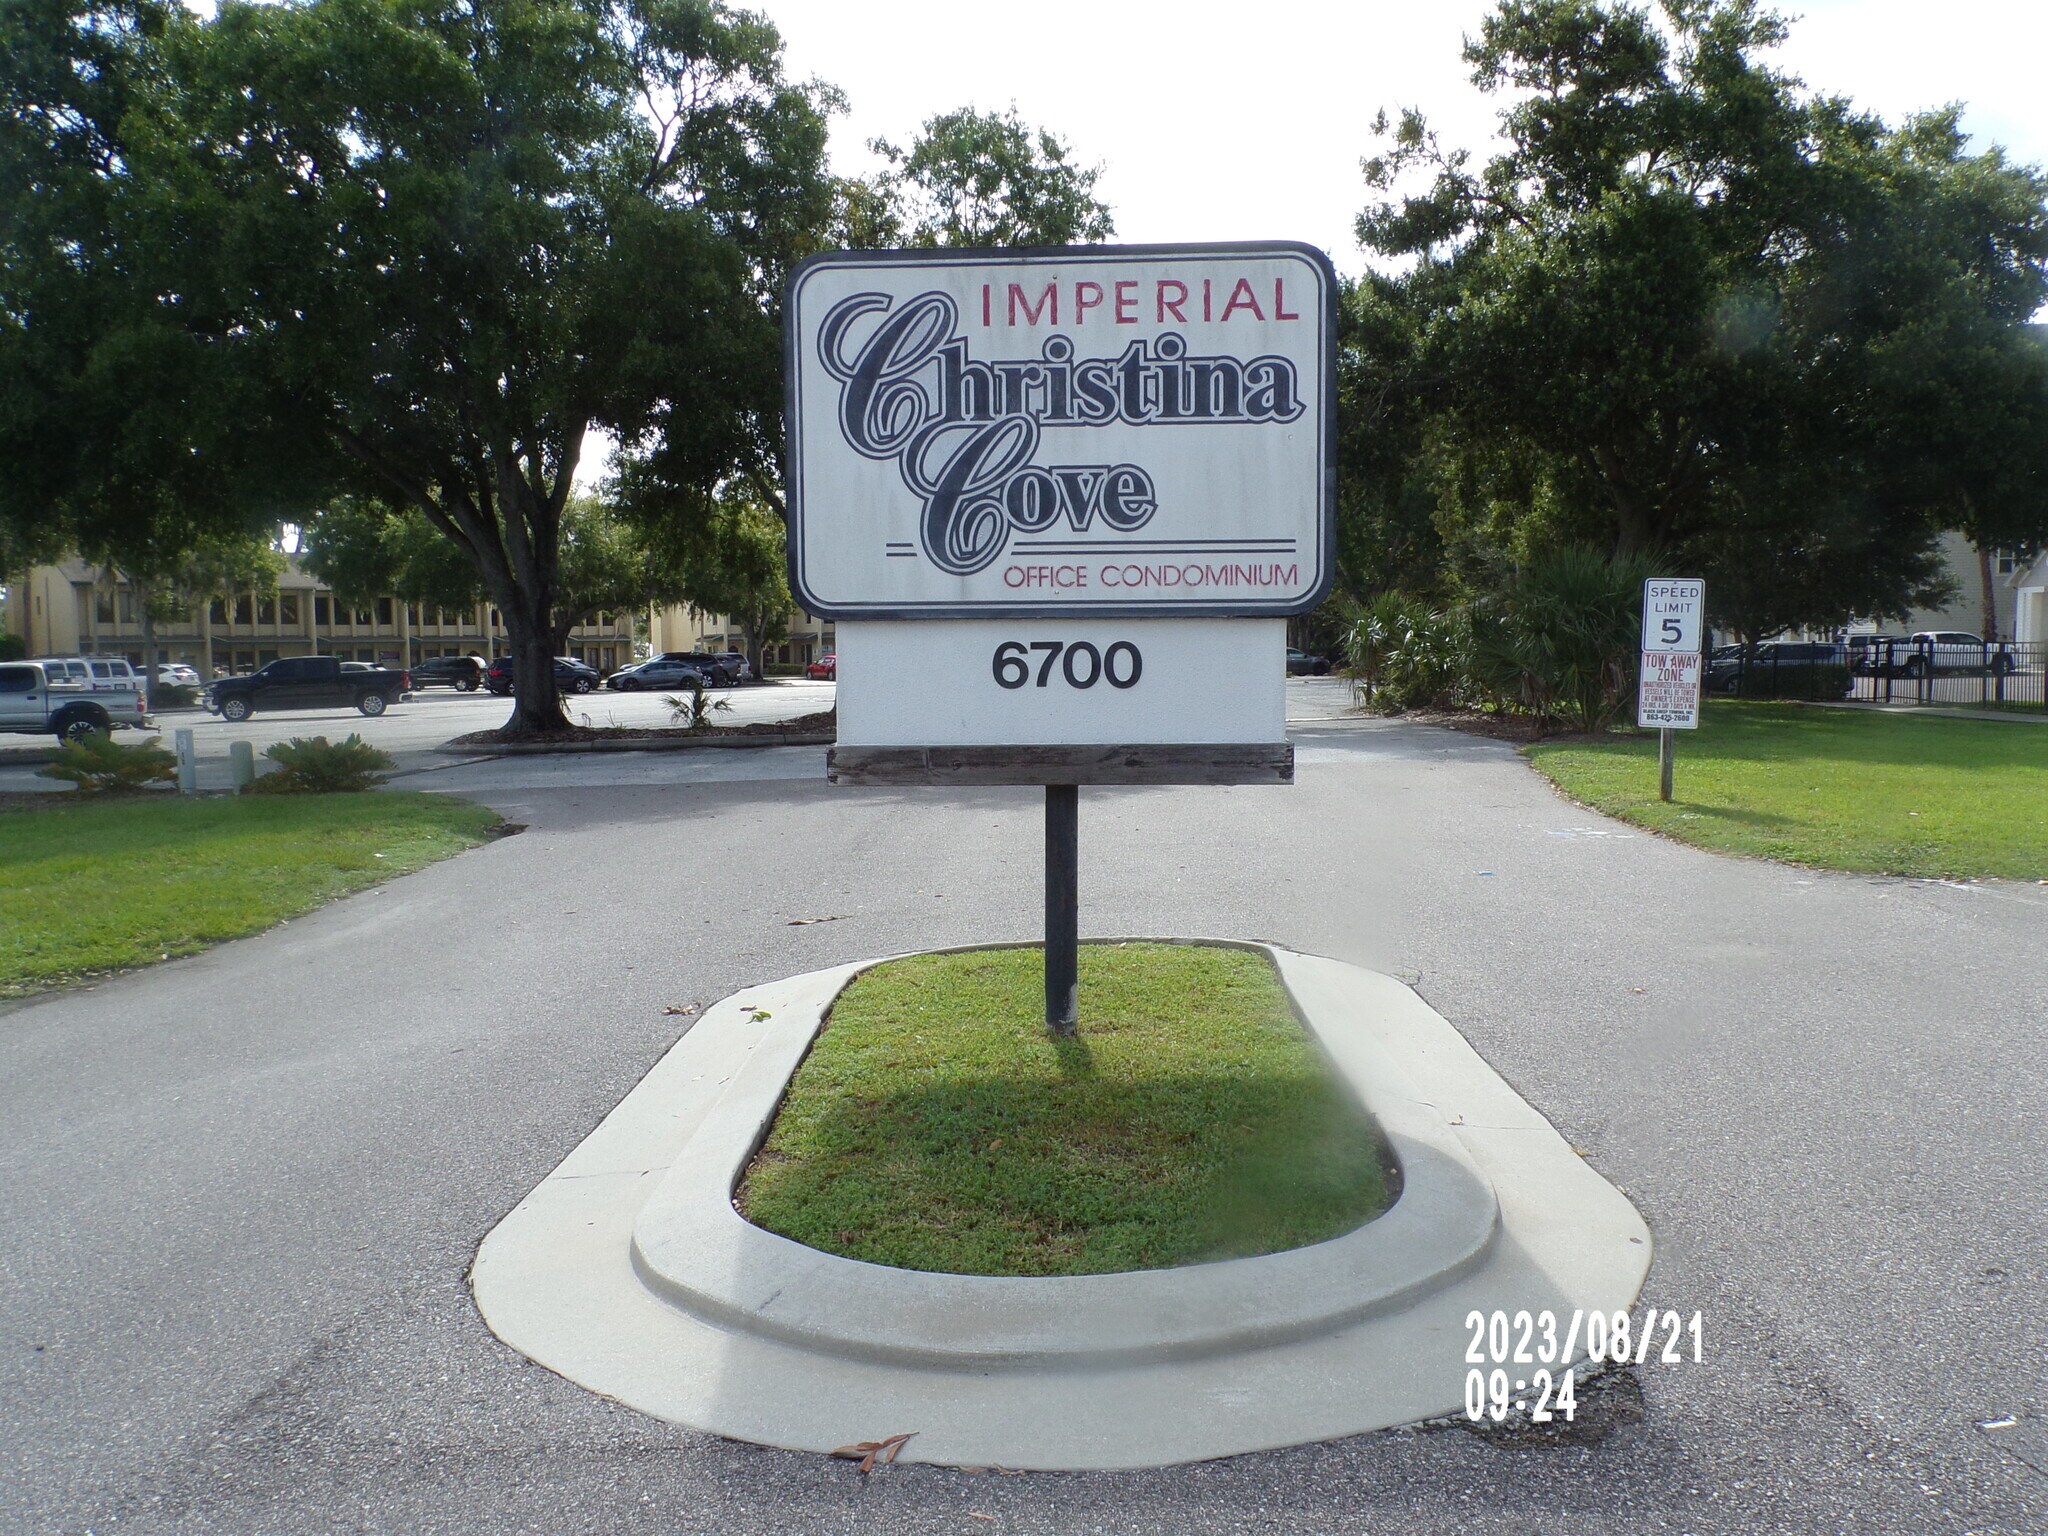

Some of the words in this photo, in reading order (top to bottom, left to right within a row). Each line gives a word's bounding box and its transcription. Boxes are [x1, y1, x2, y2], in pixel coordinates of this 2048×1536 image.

[982, 277, 1299, 327] IMPERIAL
[817, 290, 1306, 460] Christina
[900, 414, 1158, 576] Cove
[1003, 564, 1088, 588] OFFICE
[1101, 563, 1299, 587] CONDOMINIUM
[1650, 587, 1699, 598] SPEED
[1655, 602, 1693, 613] LIMIT
[1661, 618, 1682, 644] 5
[992, 641, 1143, 690] 6700
[1646, 654, 1667, 668] TOW
[1670, 655, 1698, 669] AWAY
[1657, 668, 1684, 682] ZONE
[1663, 688, 1673, 696] WILL
[1681, 689, 1696, 697] TOWED
[1673, 696, 1695, 704] EXPENSE
